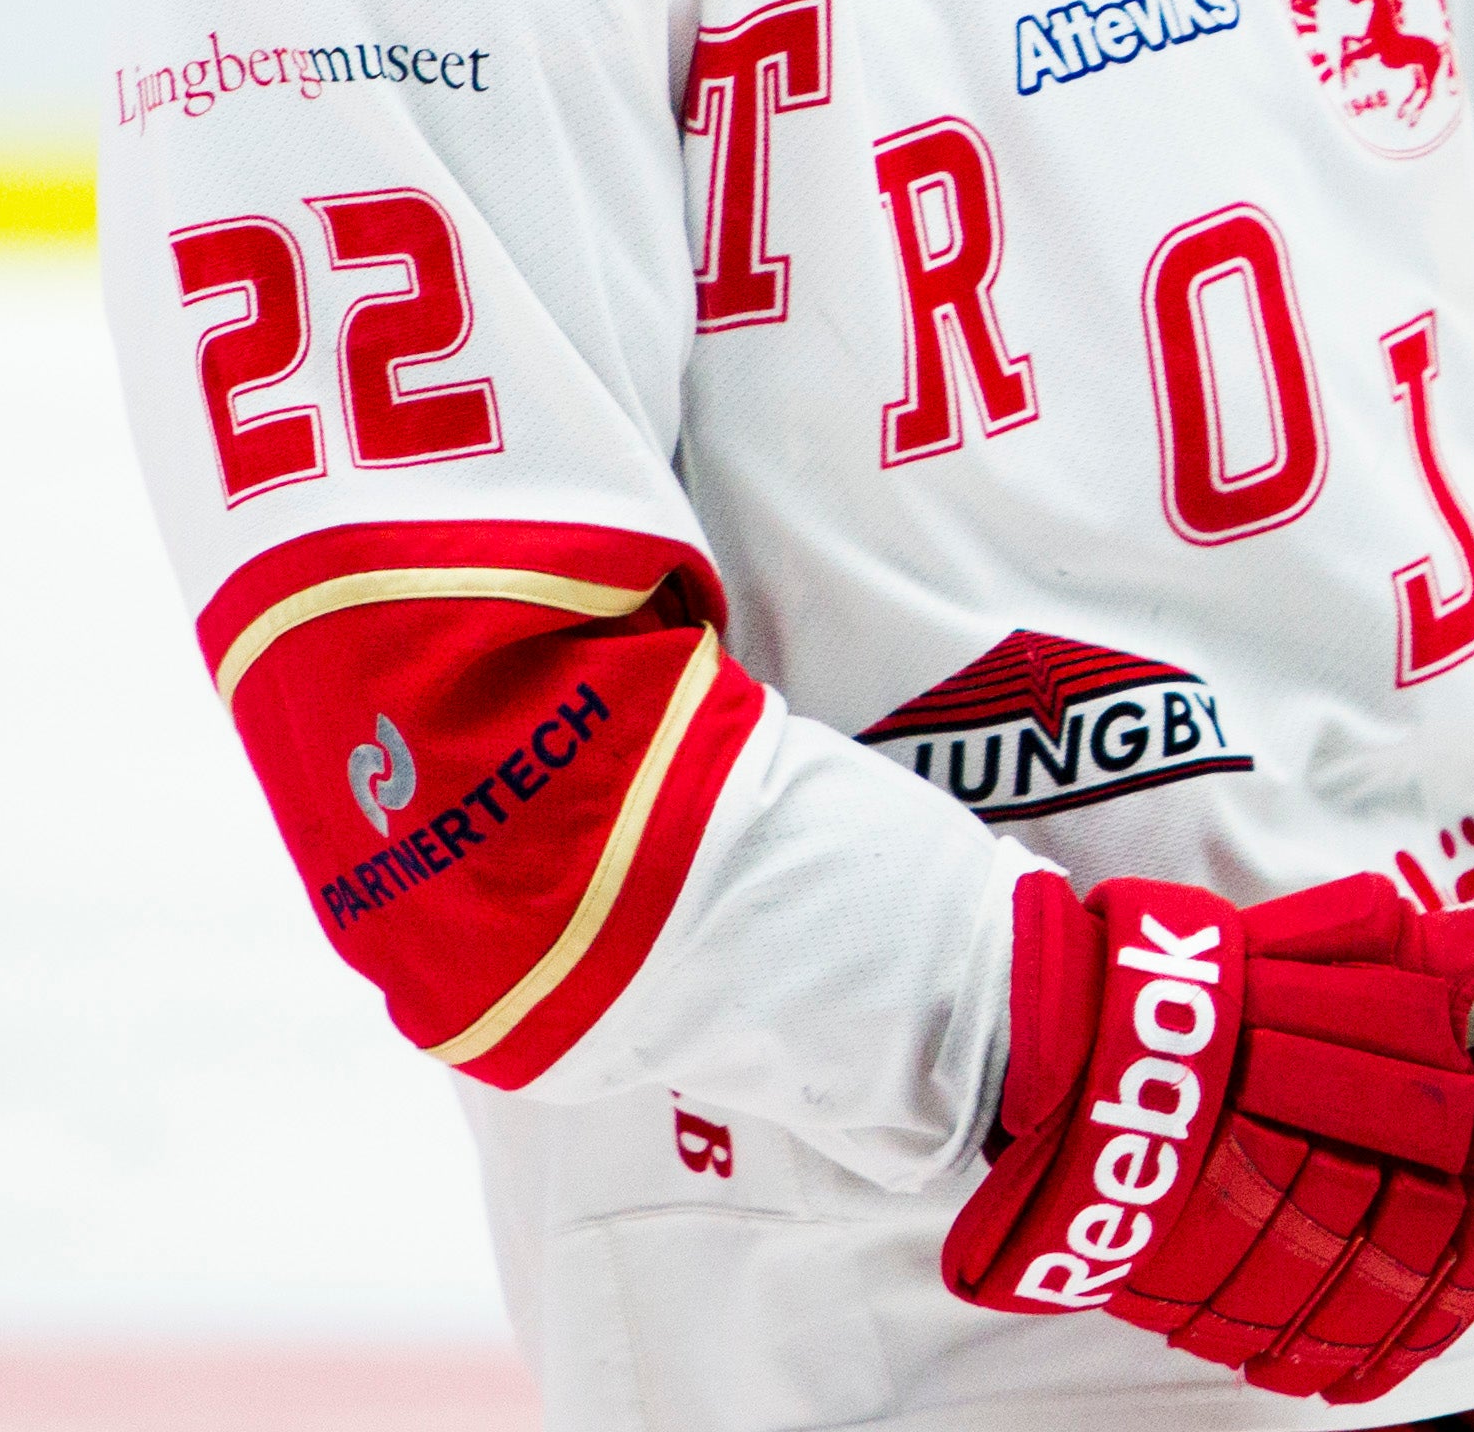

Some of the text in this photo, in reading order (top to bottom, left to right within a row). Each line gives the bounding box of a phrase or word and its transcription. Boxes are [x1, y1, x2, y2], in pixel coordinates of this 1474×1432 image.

[115, 31, 491, 137] Ljungbergmuseet
[168, 185, 505, 511] 22
[320, 682, 611, 931] PARTNERTECH
[1013, 913, 1221, 1309] Reebok
